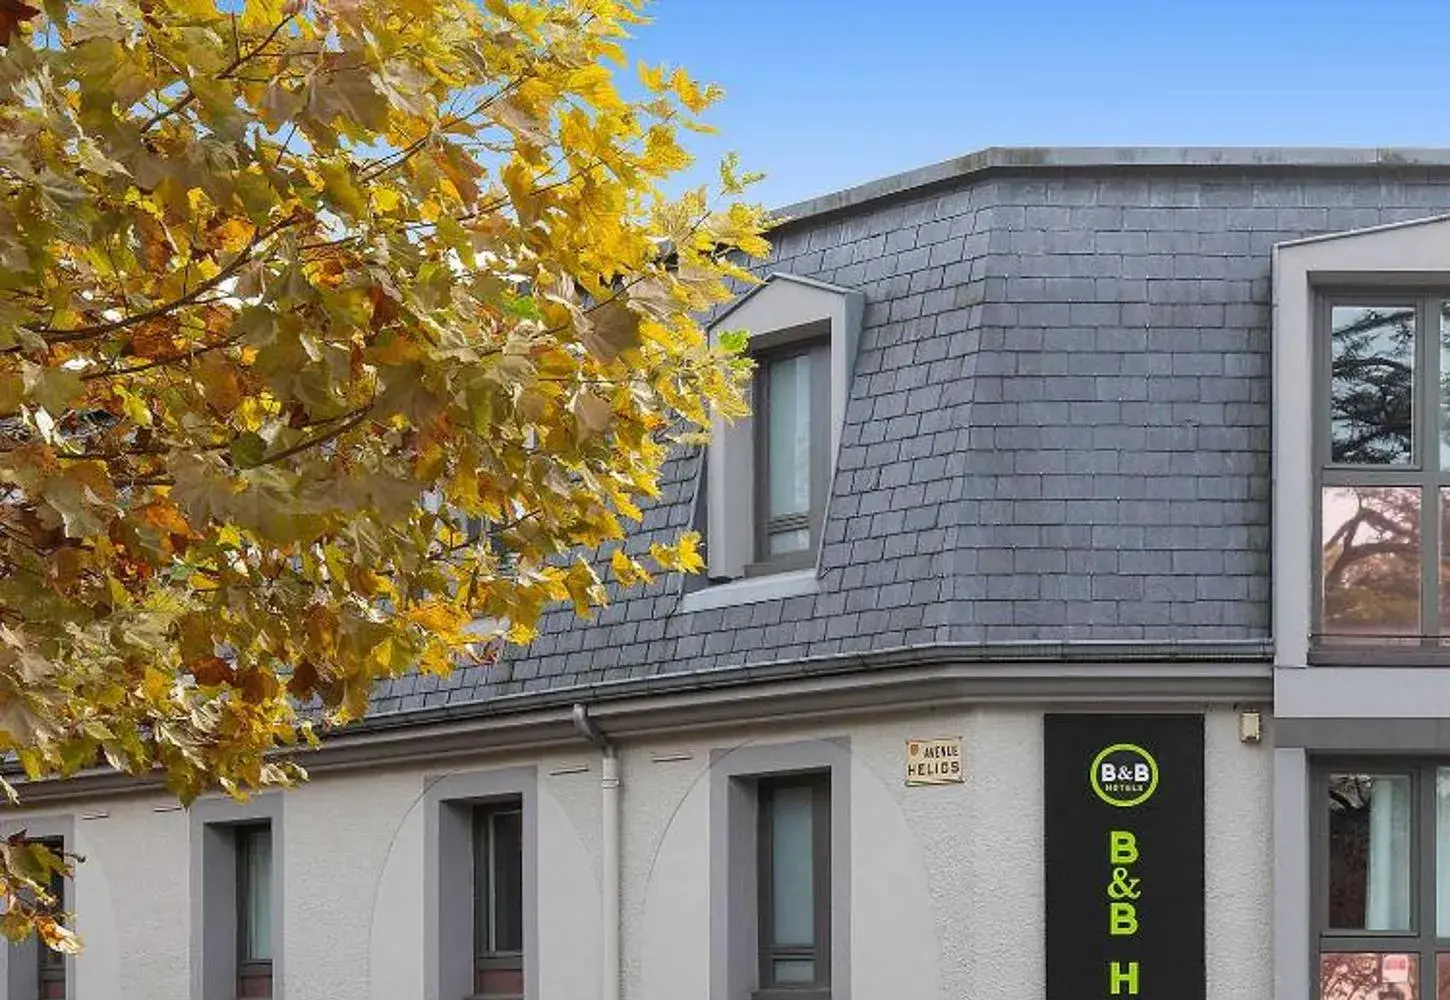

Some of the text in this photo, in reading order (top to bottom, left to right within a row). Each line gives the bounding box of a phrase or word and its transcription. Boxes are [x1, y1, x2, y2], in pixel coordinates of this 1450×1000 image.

[923, 745, 959, 758] AVENUE
[908, 761, 960, 776] HELIOS
[1101, 763, 1149, 782] B&B
[1105, 783, 1143, 792] HOTELS
[1108, 831, 1140, 935] B&B
